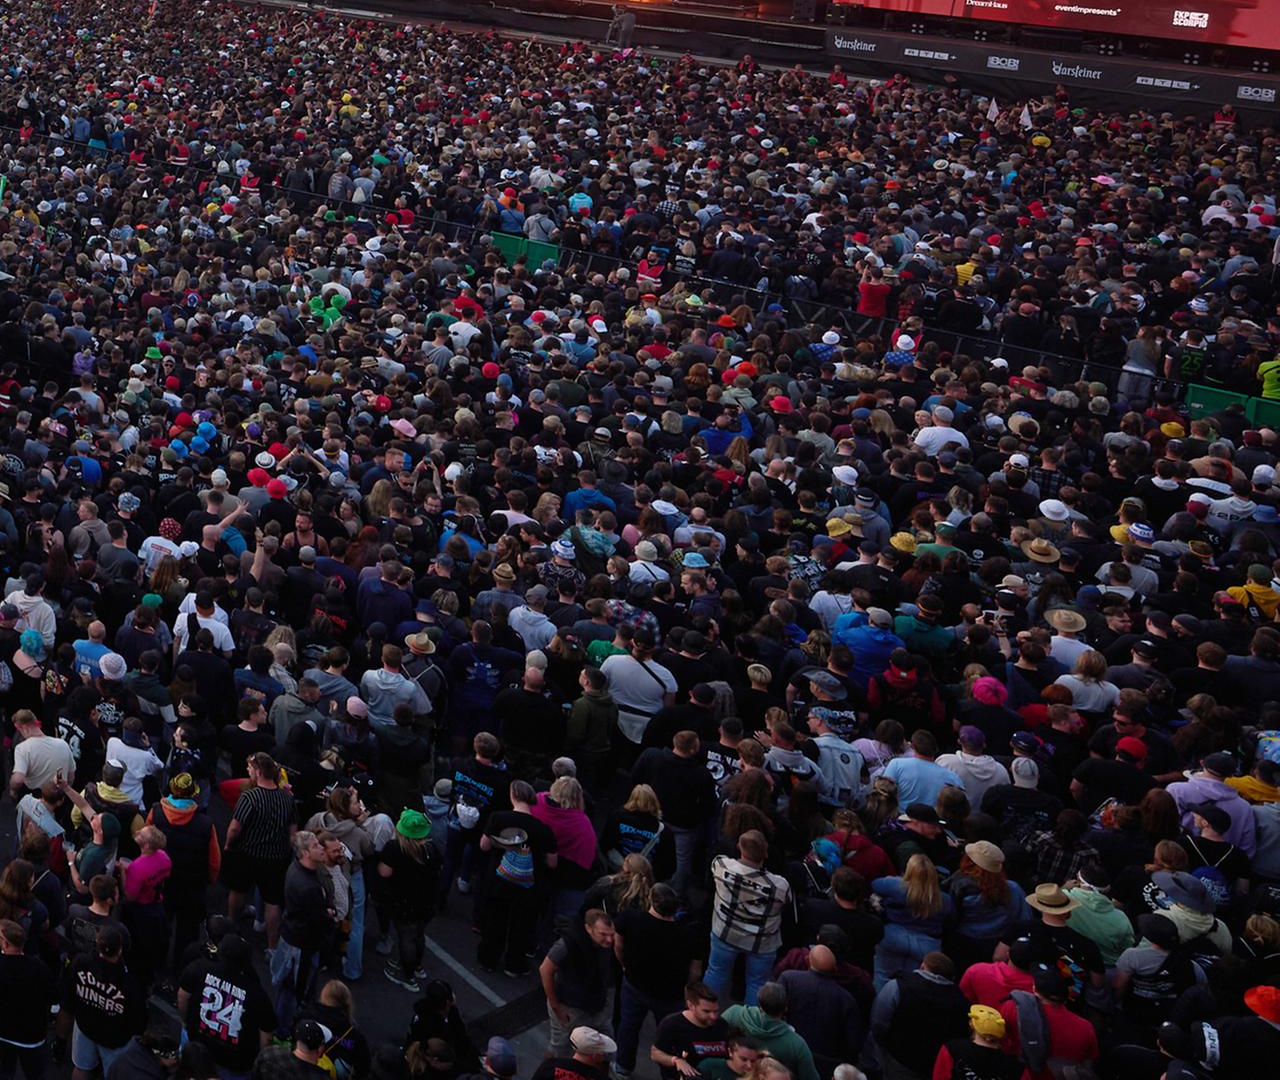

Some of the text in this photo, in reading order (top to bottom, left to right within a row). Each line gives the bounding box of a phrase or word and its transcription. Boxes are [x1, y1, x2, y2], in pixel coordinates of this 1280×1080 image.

[834, 35, 877, 52] Warsteiner
[1052, 61, 1102, 80] Warsteiner
[76, 983, 124, 1014] NINERS
[200, 986, 244, 1039] 24
